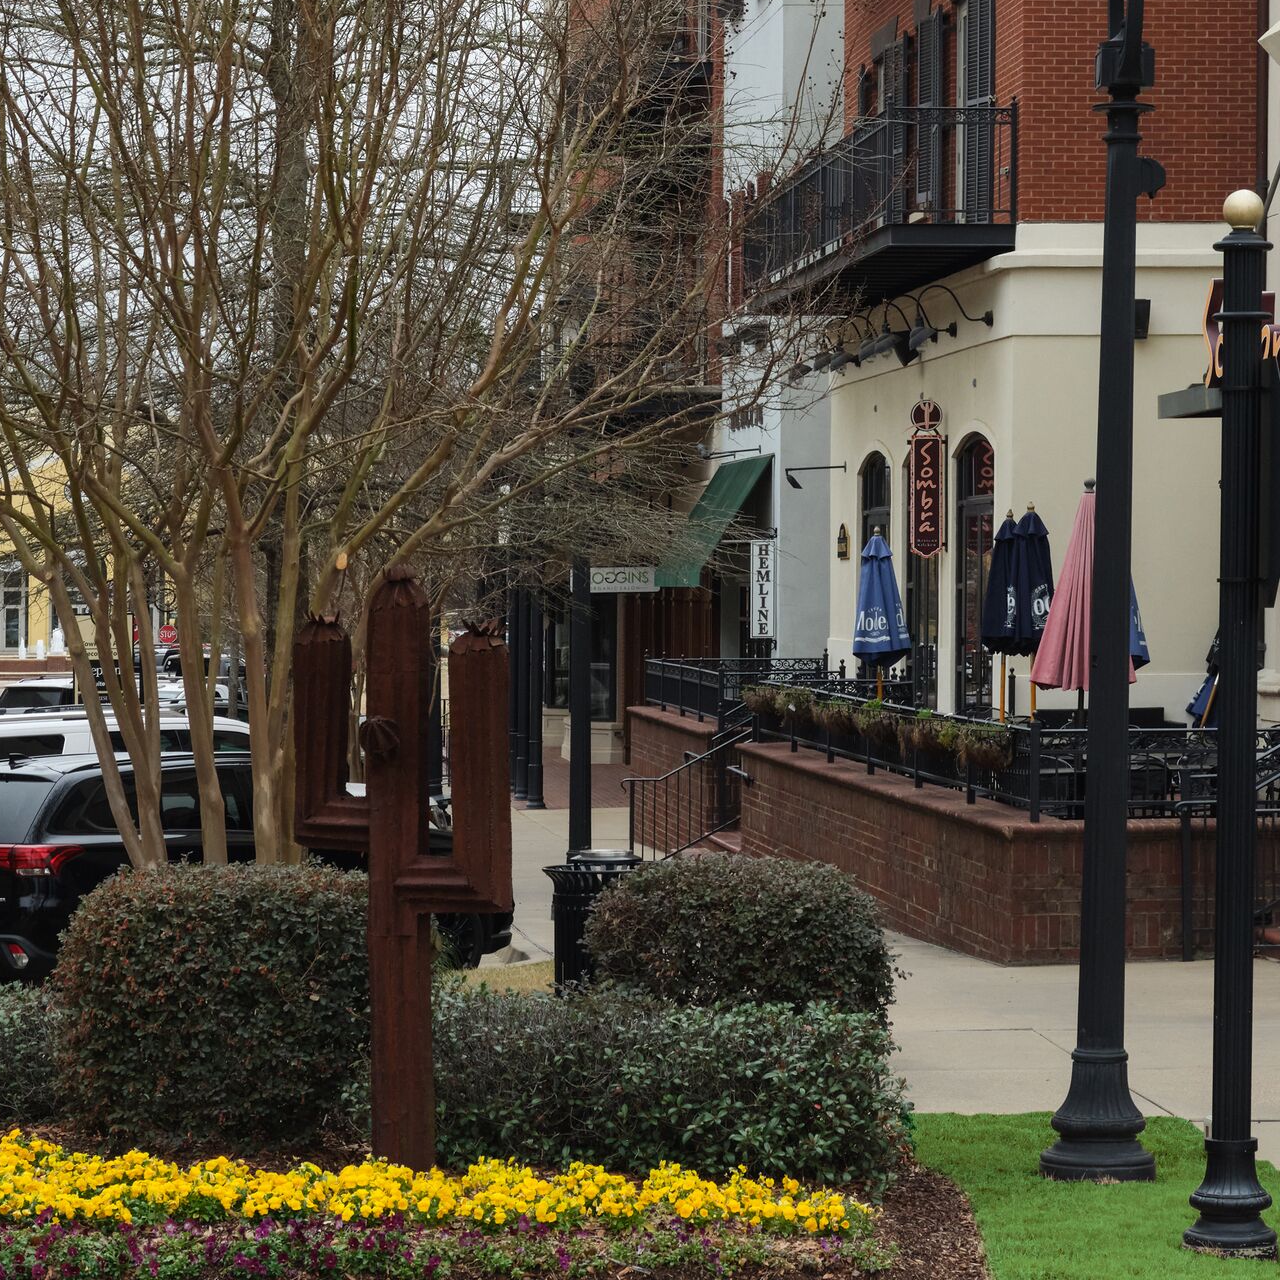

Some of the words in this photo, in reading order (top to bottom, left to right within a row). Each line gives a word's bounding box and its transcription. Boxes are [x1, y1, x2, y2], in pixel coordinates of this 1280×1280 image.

[916, 440, 937, 532] Sombra
[592, 571, 649, 584] OGGINS
[756, 543, 770, 635] HEMLINE
